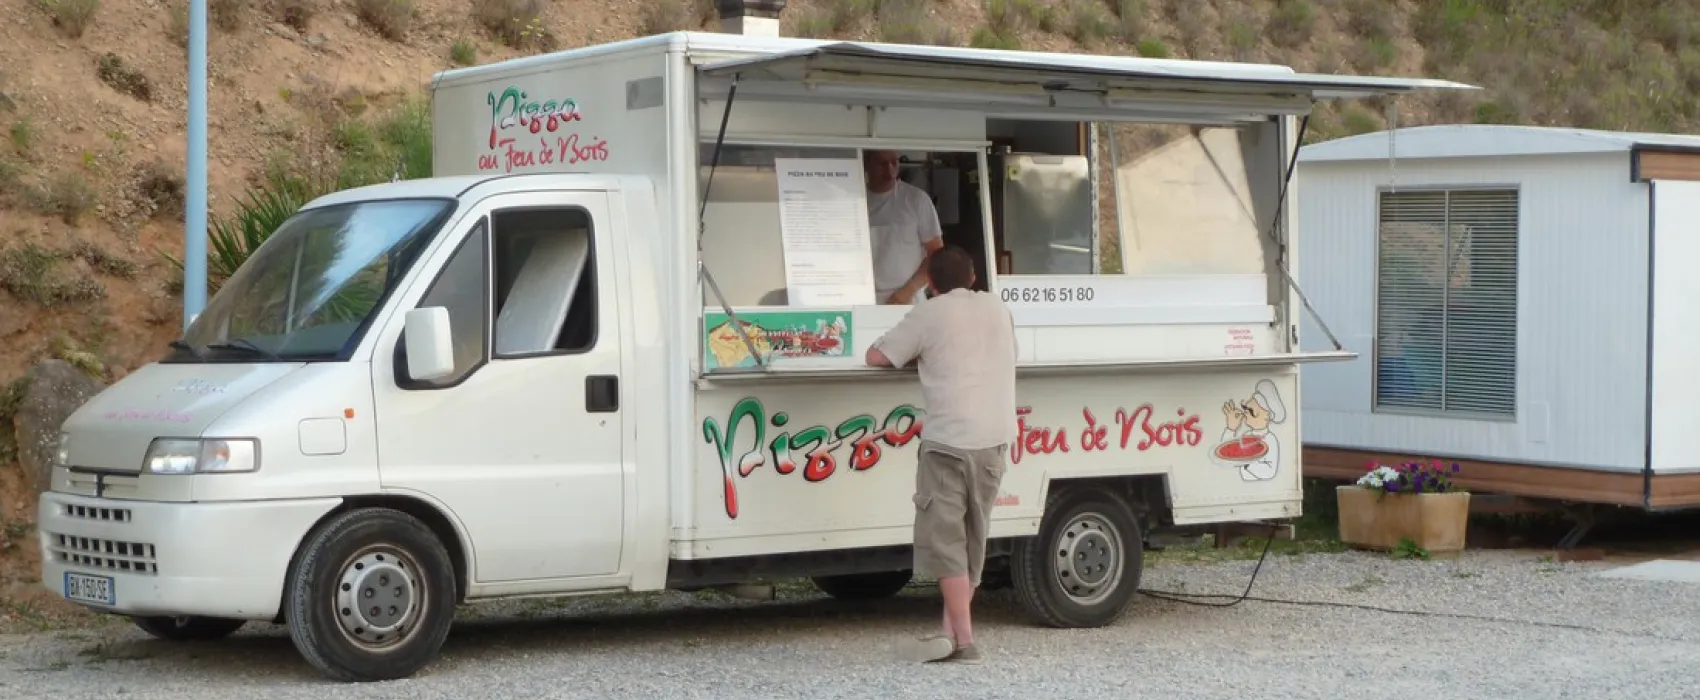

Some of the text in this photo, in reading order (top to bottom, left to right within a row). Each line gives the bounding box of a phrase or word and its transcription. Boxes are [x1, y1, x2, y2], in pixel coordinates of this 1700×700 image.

[487, 84, 581, 150] Pizza
[478, 153, 499, 170] au
[499, 137, 535, 173] Feu
[557, 132, 608, 164] Bois
[1001, 287, 1095, 302] 06 62 16 51 80
[703, 396, 926, 520] Pizza
[1010, 405, 1070, 464] Feu
[1115, 403, 1203, 452] Bois
